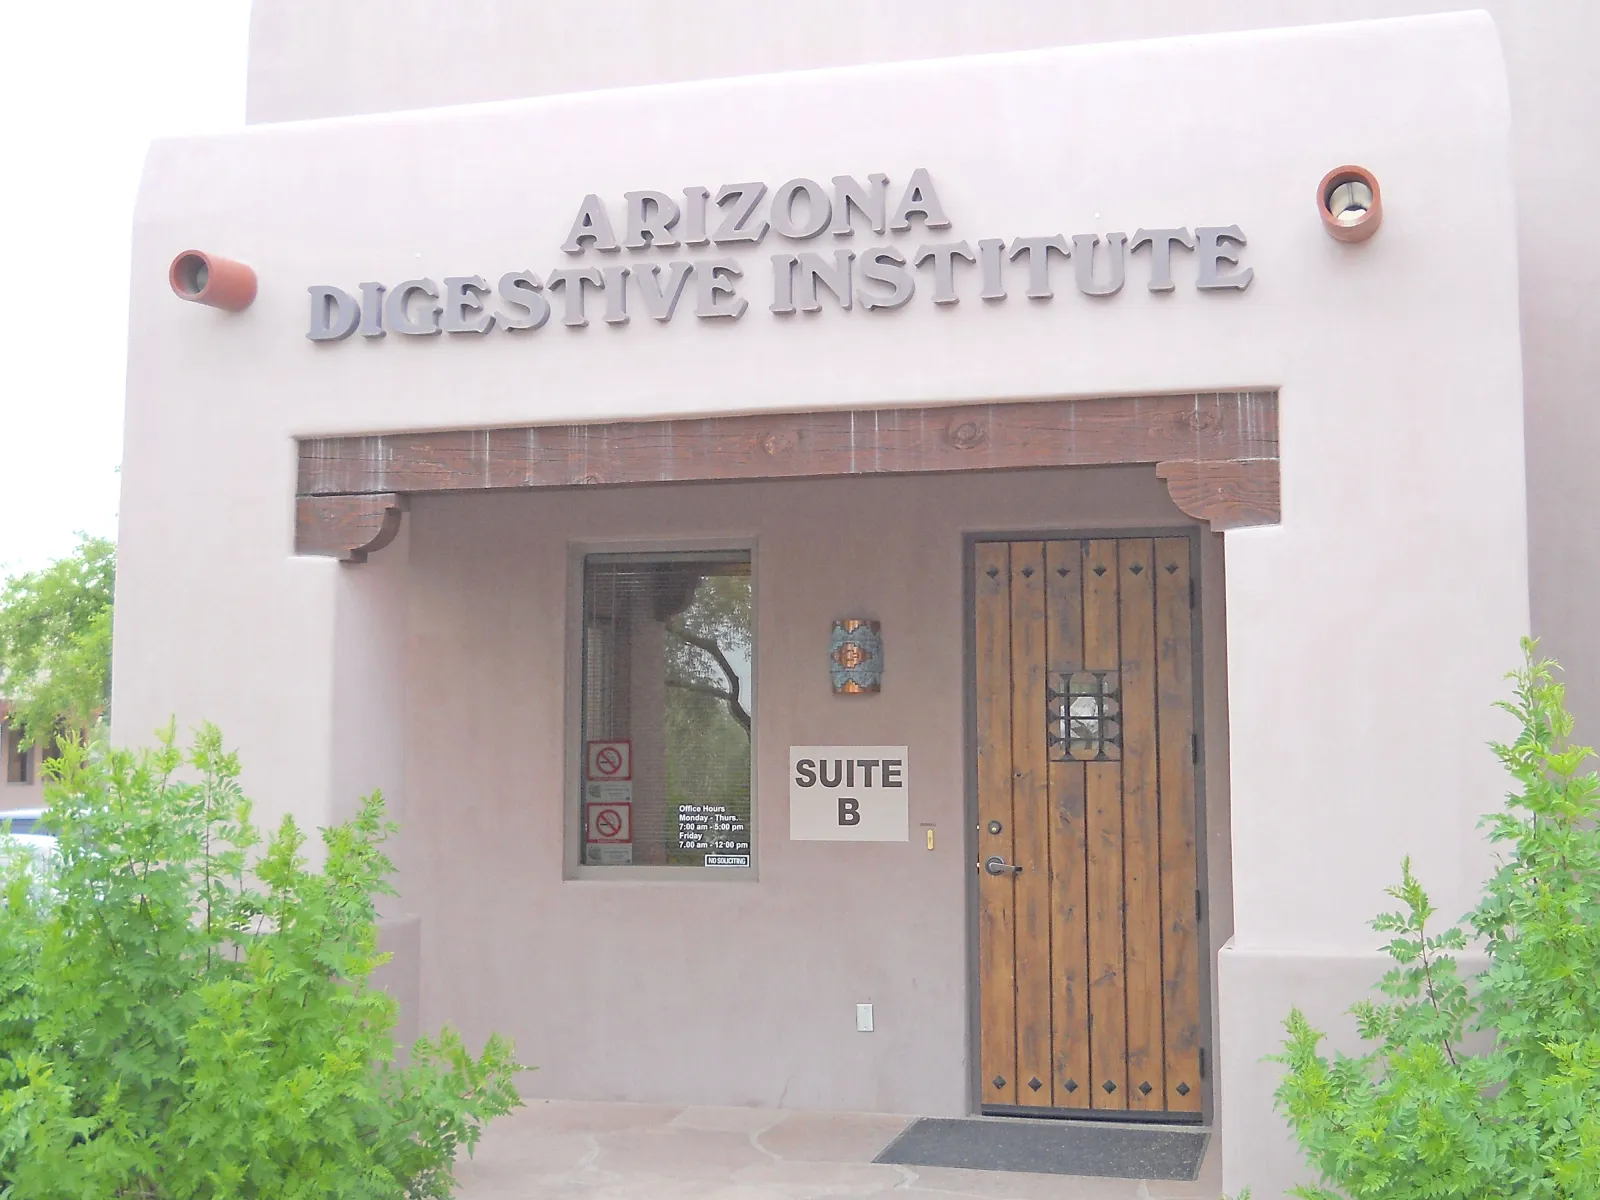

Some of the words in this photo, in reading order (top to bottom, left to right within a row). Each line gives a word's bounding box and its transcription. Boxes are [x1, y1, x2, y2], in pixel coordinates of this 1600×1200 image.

[561, 167, 952, 255] ARIZONA
[305, 257, 750, 343] DIGESTIVE
[768, 223, 1255, 317] INSTITUTE
[795, 758, 903, 788] SUITE
[679, 814, 708, 822] Monday
[838, 797, 861, 826] B
[679, 832, 703, 840] Friday
